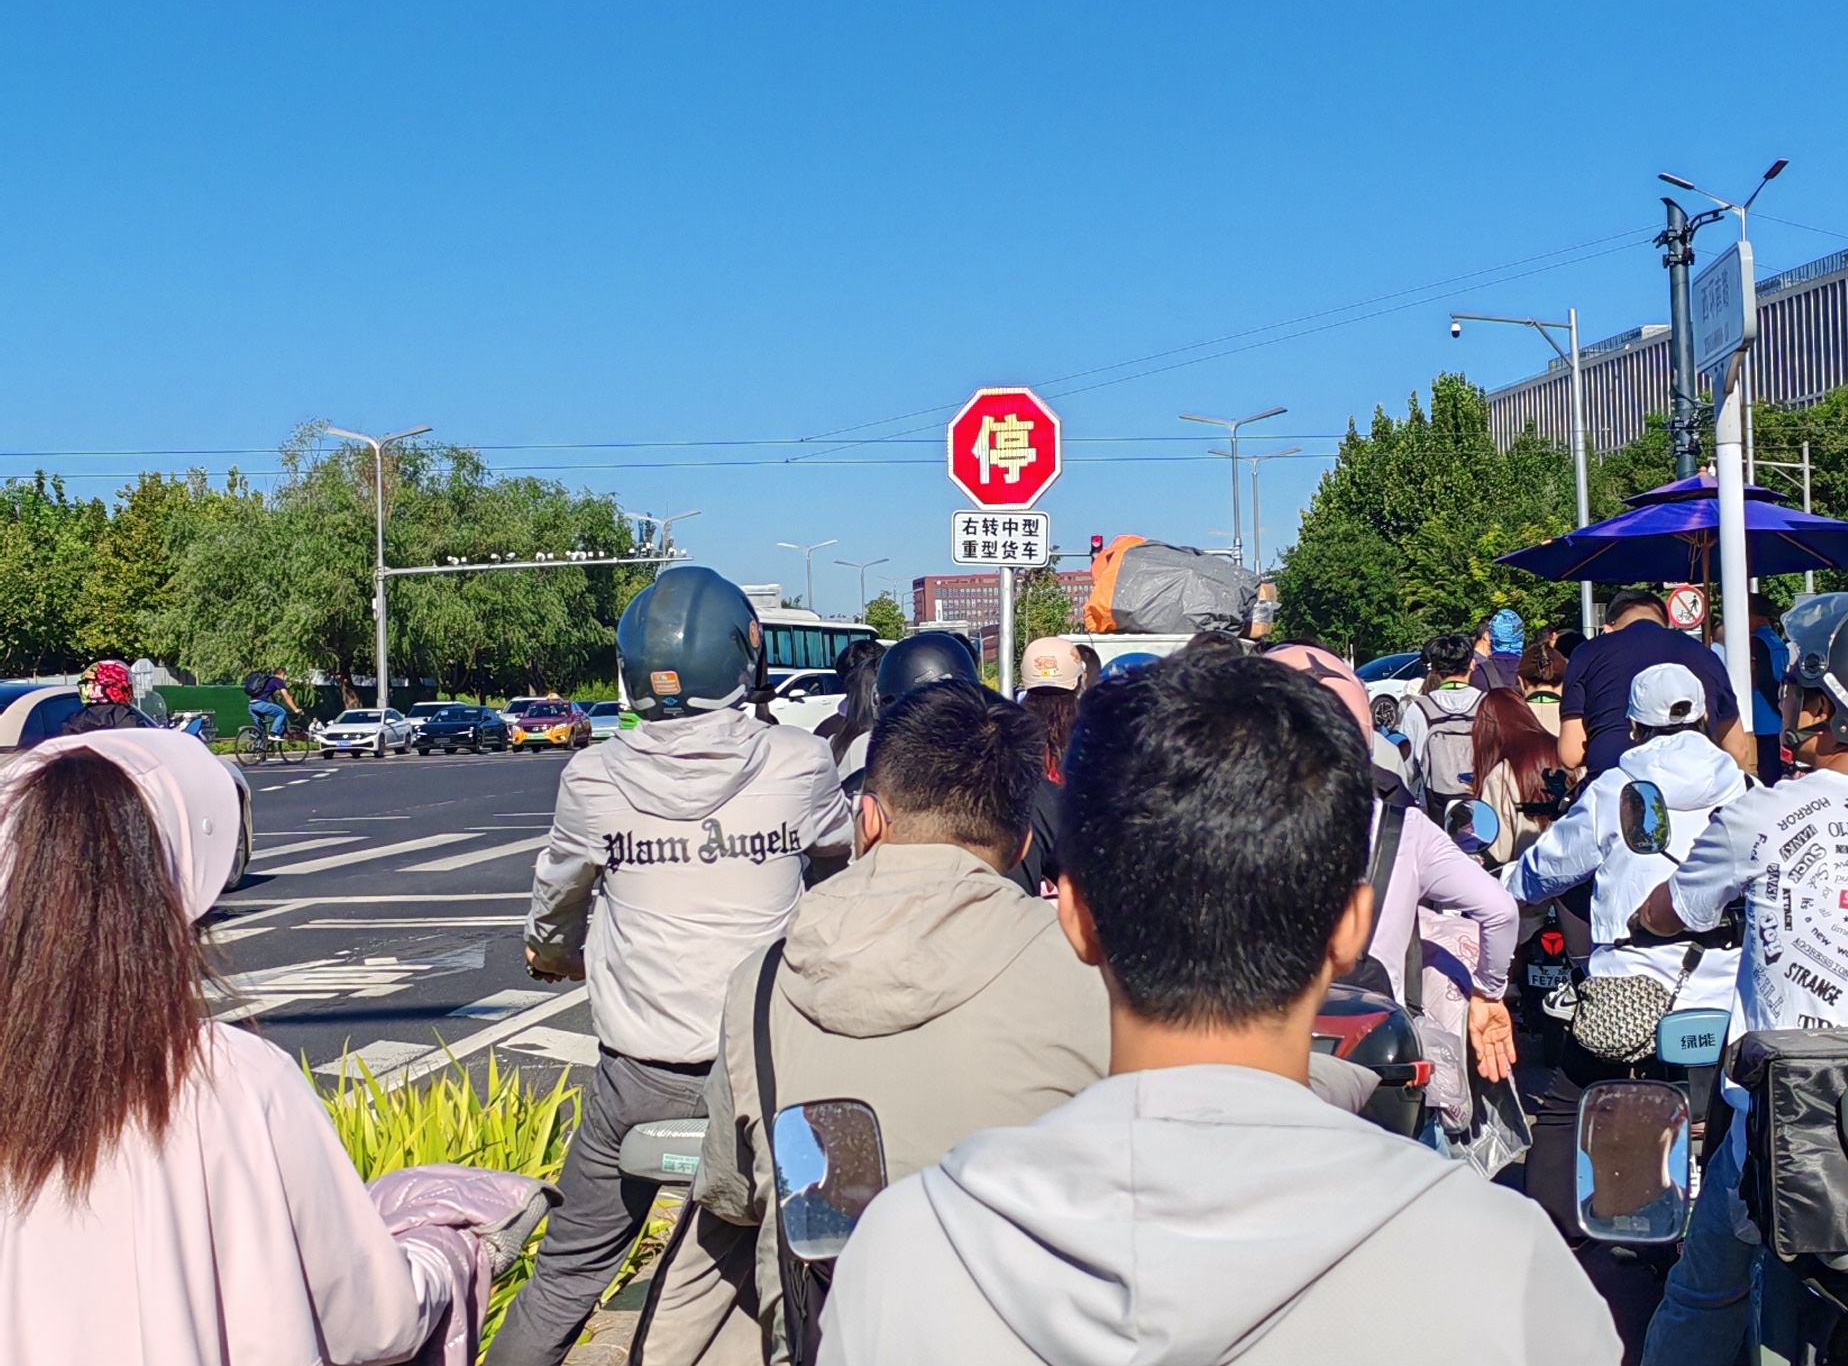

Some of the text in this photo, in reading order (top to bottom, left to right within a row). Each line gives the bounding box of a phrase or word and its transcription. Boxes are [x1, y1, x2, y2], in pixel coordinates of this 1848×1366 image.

[971, 413, 1037, 484] 停
[962, 517, 1039, 537] 右转中型
[962, 540, 1038, 560] 重型货车
[1776, 797, 1831, 831] HORROR
[602, 830, 691, 874] Plam
[1787, 843, 1827, 884] SUCK
[1759, 912, 1784, 966] JOY
[1810, 927, 1832, 946] new
[1784, 962, 1844, 1007] STRANGE
